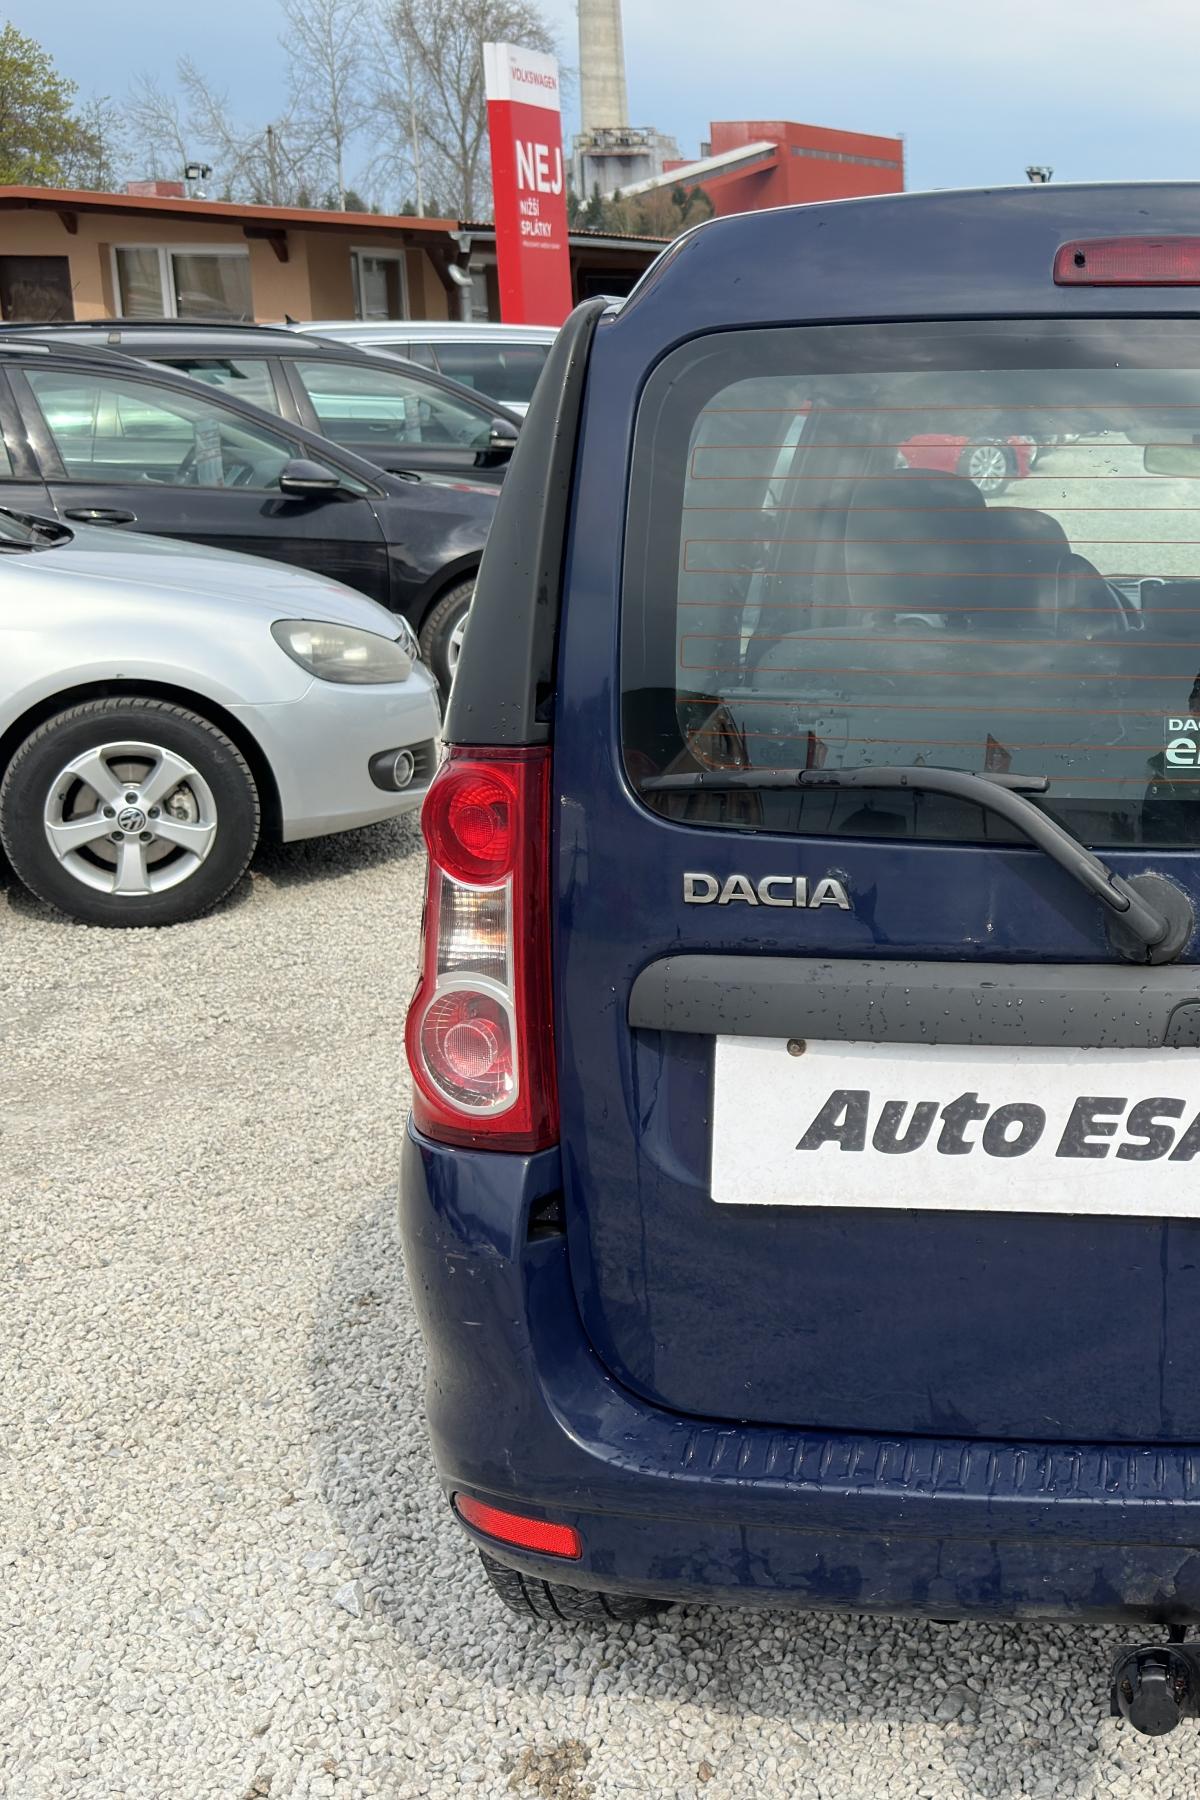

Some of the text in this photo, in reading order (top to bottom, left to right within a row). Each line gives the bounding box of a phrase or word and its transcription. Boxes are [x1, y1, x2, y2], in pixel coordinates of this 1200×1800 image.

[511, 66, 557, 90] VOLKSWAGEN
[515, 139, 563, 196] NEJ
[683, 872, 850, 911] DACIA
[795, 1089, 1047, 1158] Auto
